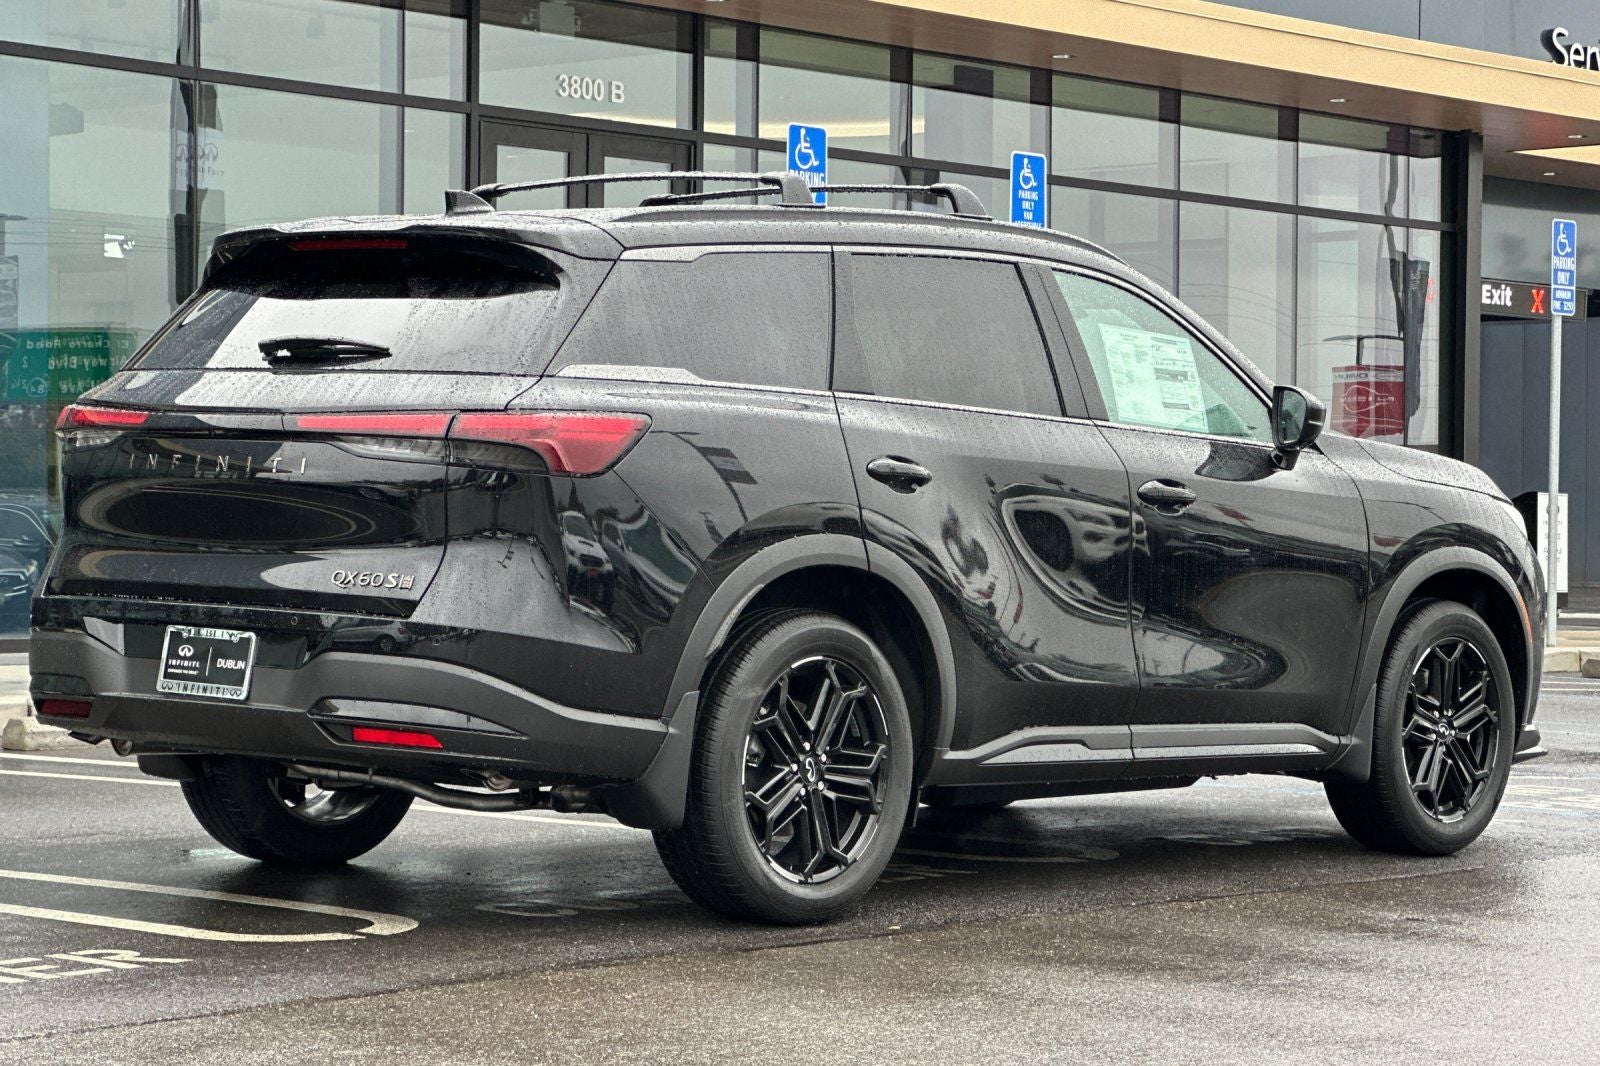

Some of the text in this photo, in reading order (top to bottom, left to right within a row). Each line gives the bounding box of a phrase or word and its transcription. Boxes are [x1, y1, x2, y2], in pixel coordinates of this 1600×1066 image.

[556, 74, 625, 103] 3800 B
[789, 169, 825, 187] RKING
[1018, 189, 1039, 200] PARKING
[1021, 200, 1035, 211] ONLY
[1553, 256, 1575, 270] PARKING
[1557, 271, 1570, 285] ONLY
[1481, 284, 1512, 307] Exit
[129, 453, 307, 475] INFINITI
[168, 659, 200, 668] INFINITI
[216, 659, 246, 670] DUBLIN
[175, 683, 228, 694] INFINITI
